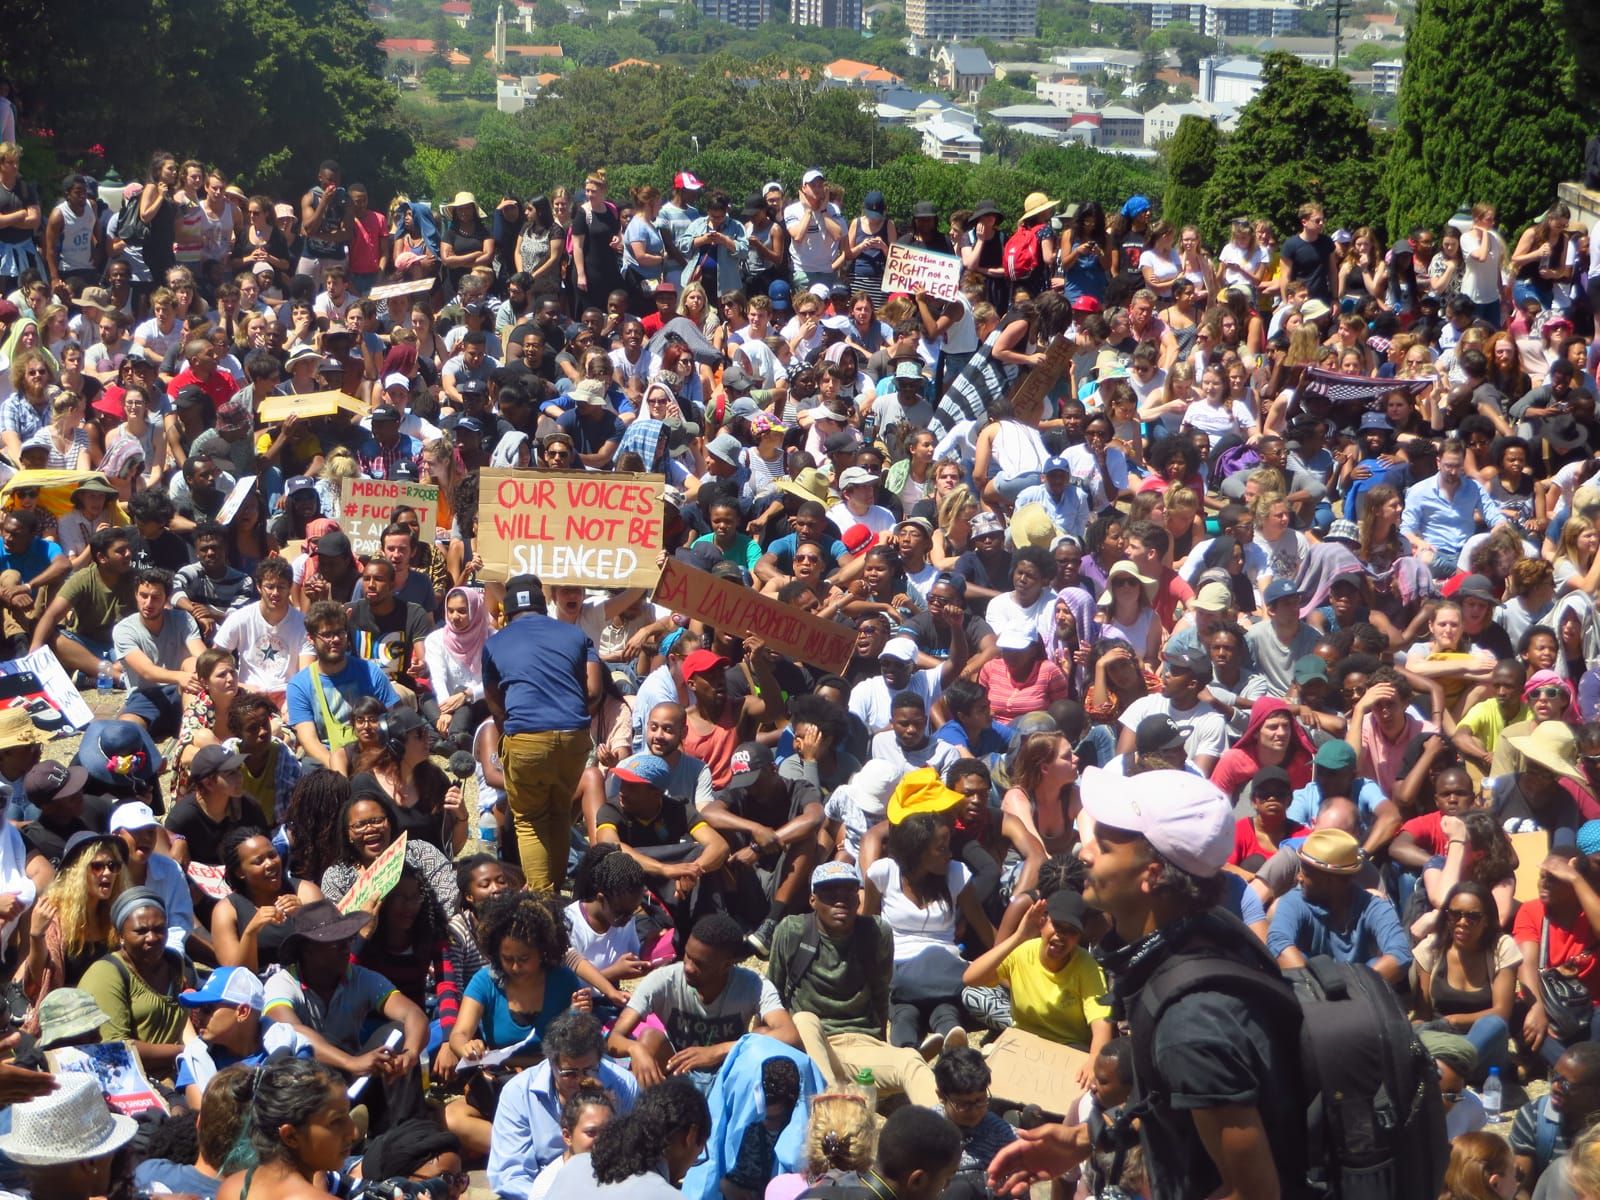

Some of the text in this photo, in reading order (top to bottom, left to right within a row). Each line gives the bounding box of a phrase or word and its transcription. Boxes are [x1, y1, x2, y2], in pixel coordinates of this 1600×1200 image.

[888, 259, 929, 278] RIGHT
[927, 270, 942, 278] not
[351, 482, 399, 498] MBChB
[497, 480, 654, 515] OUR VOICES
[348, 521, 362, 536] I
[494, 513, 661, 549] WILL NOT BE
[510, 544, 638, 579] SILENCED
[655, 567, 688, 608] SA
[696, 583, 742, 624] LAW
[676, 1015, 736, 1037] WORK
